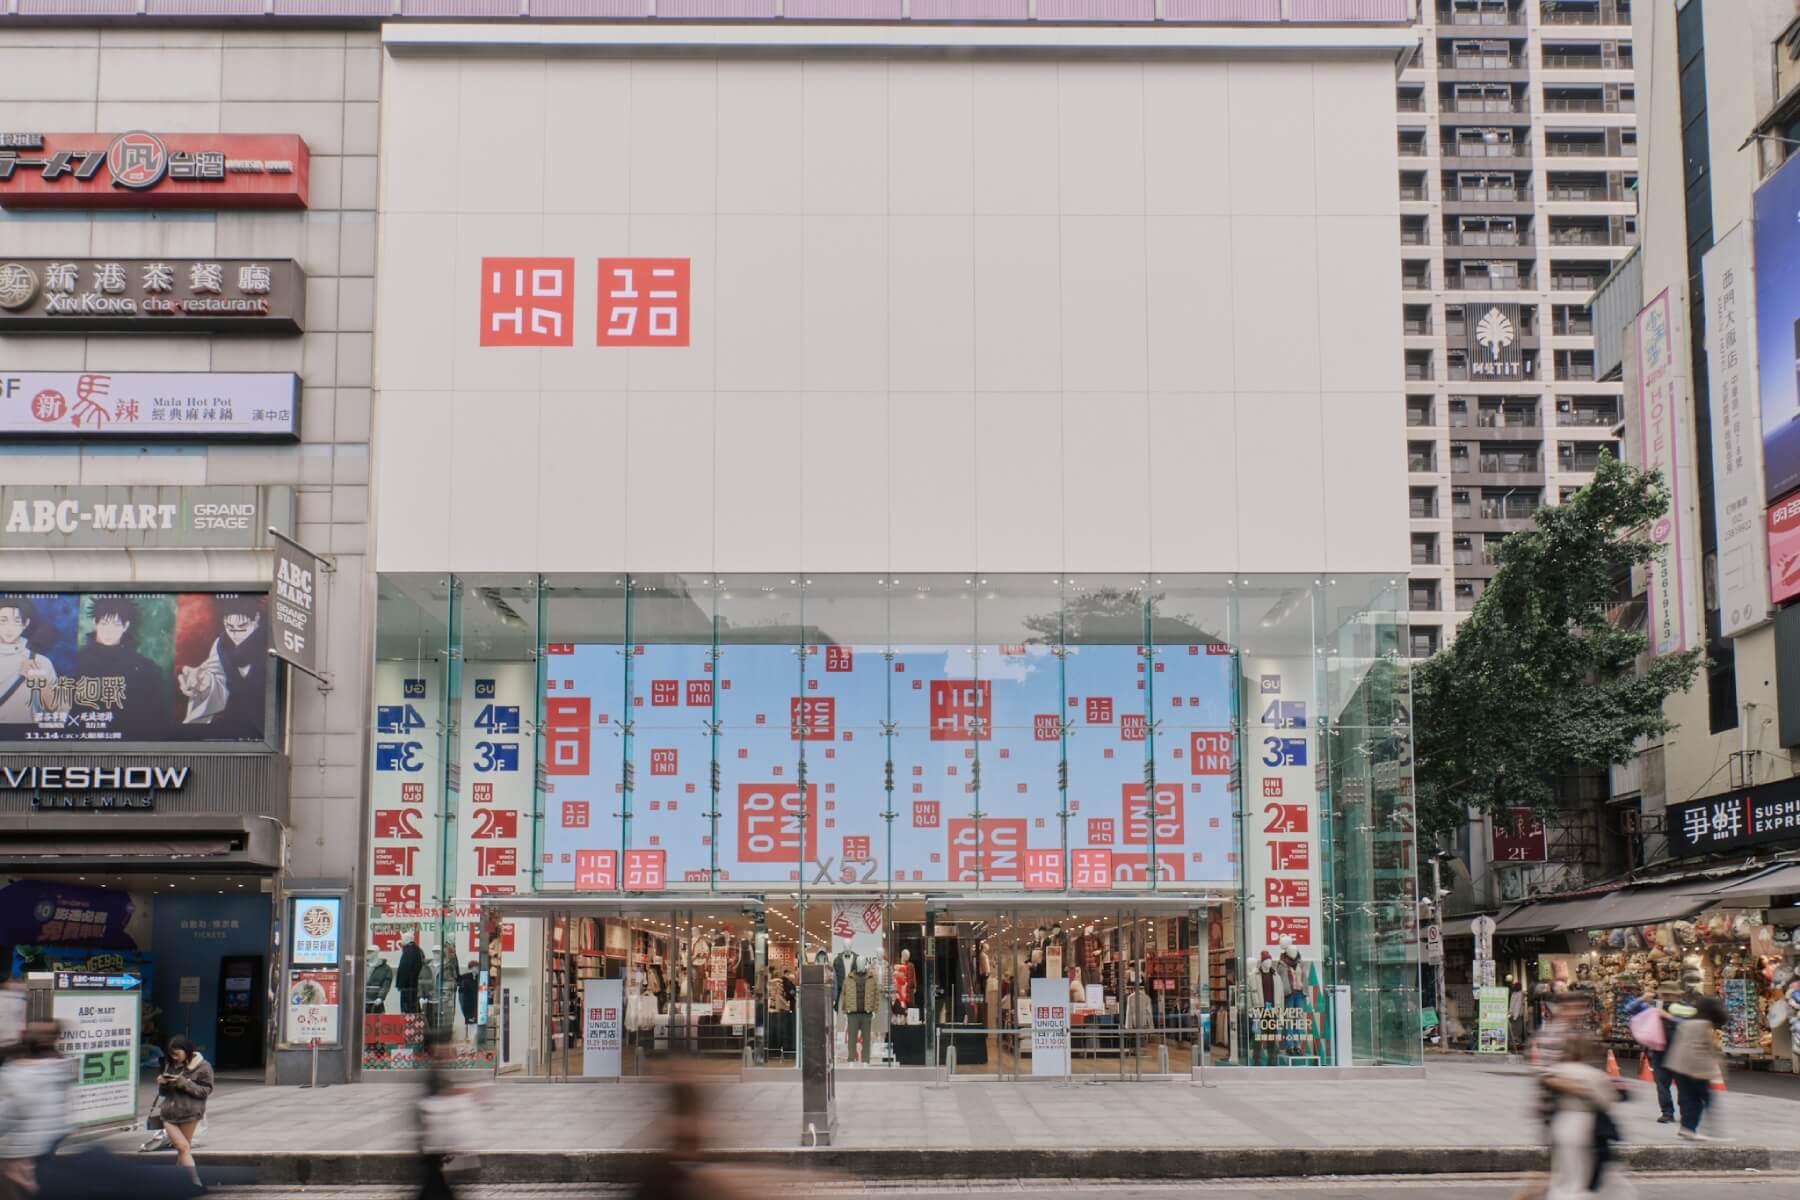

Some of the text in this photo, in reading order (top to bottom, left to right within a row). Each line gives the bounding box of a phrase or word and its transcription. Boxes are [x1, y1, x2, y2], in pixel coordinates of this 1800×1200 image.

[45, 263, 271, 293] 新港茶餐廳
[184, 298, 263, 310] restaurant
[153, 397, 233, 407] Mala Hot Pot
[152, 408, 233, 421] 經典麻辣鍋
[252, 409, 290, 421] 漢中店
[5, 500, 176, 533] ABC-MART
[194, 504, 255, 516] GRAND
[194, 517, 249, 529] STAGE
[277, 558, 312, 594] ABC
[277, 580, 312, 609] MART
[276, 602, 307, 623] GRAND
[276, 611, 304, 631] STAGE
[284, 630, 305, 653] 5F
[476, 684, 495, 694] GU
[1262, 680, 1280, 689] GU
[474, 704, 508, 735] 4F
[1261, 700, 1295, 729] 4F
[473, 741, 505, 772] 3F
[1262, 736, 1295, 767] 3F
[4, 766, 190, 788] VIESHOW
[1265, 779, 1280, 787] UNI
[1265, 787, 1281, 796] QLO
[32, 797, 153, 807] CINEMAS
[915, 803, 936, 814] UNI
[471, 808, 504, 839] 2F
[915, 815, 937, 826] QLO
[1264, 802, 1295, 833] 2F
[1683, 799, 1742, 845] 爭鮮
[473, 846, 496, 877] 1F
[1265, 841, 1289, 870] 1F
[590, 1021, 617, 1029] UNIQLO
[1037, 1020, 1064, 1028] UNIQLO
[1252, 1018, 1313, 1031] TOGETHER
[84, 1051, 128, 1079] 5F
